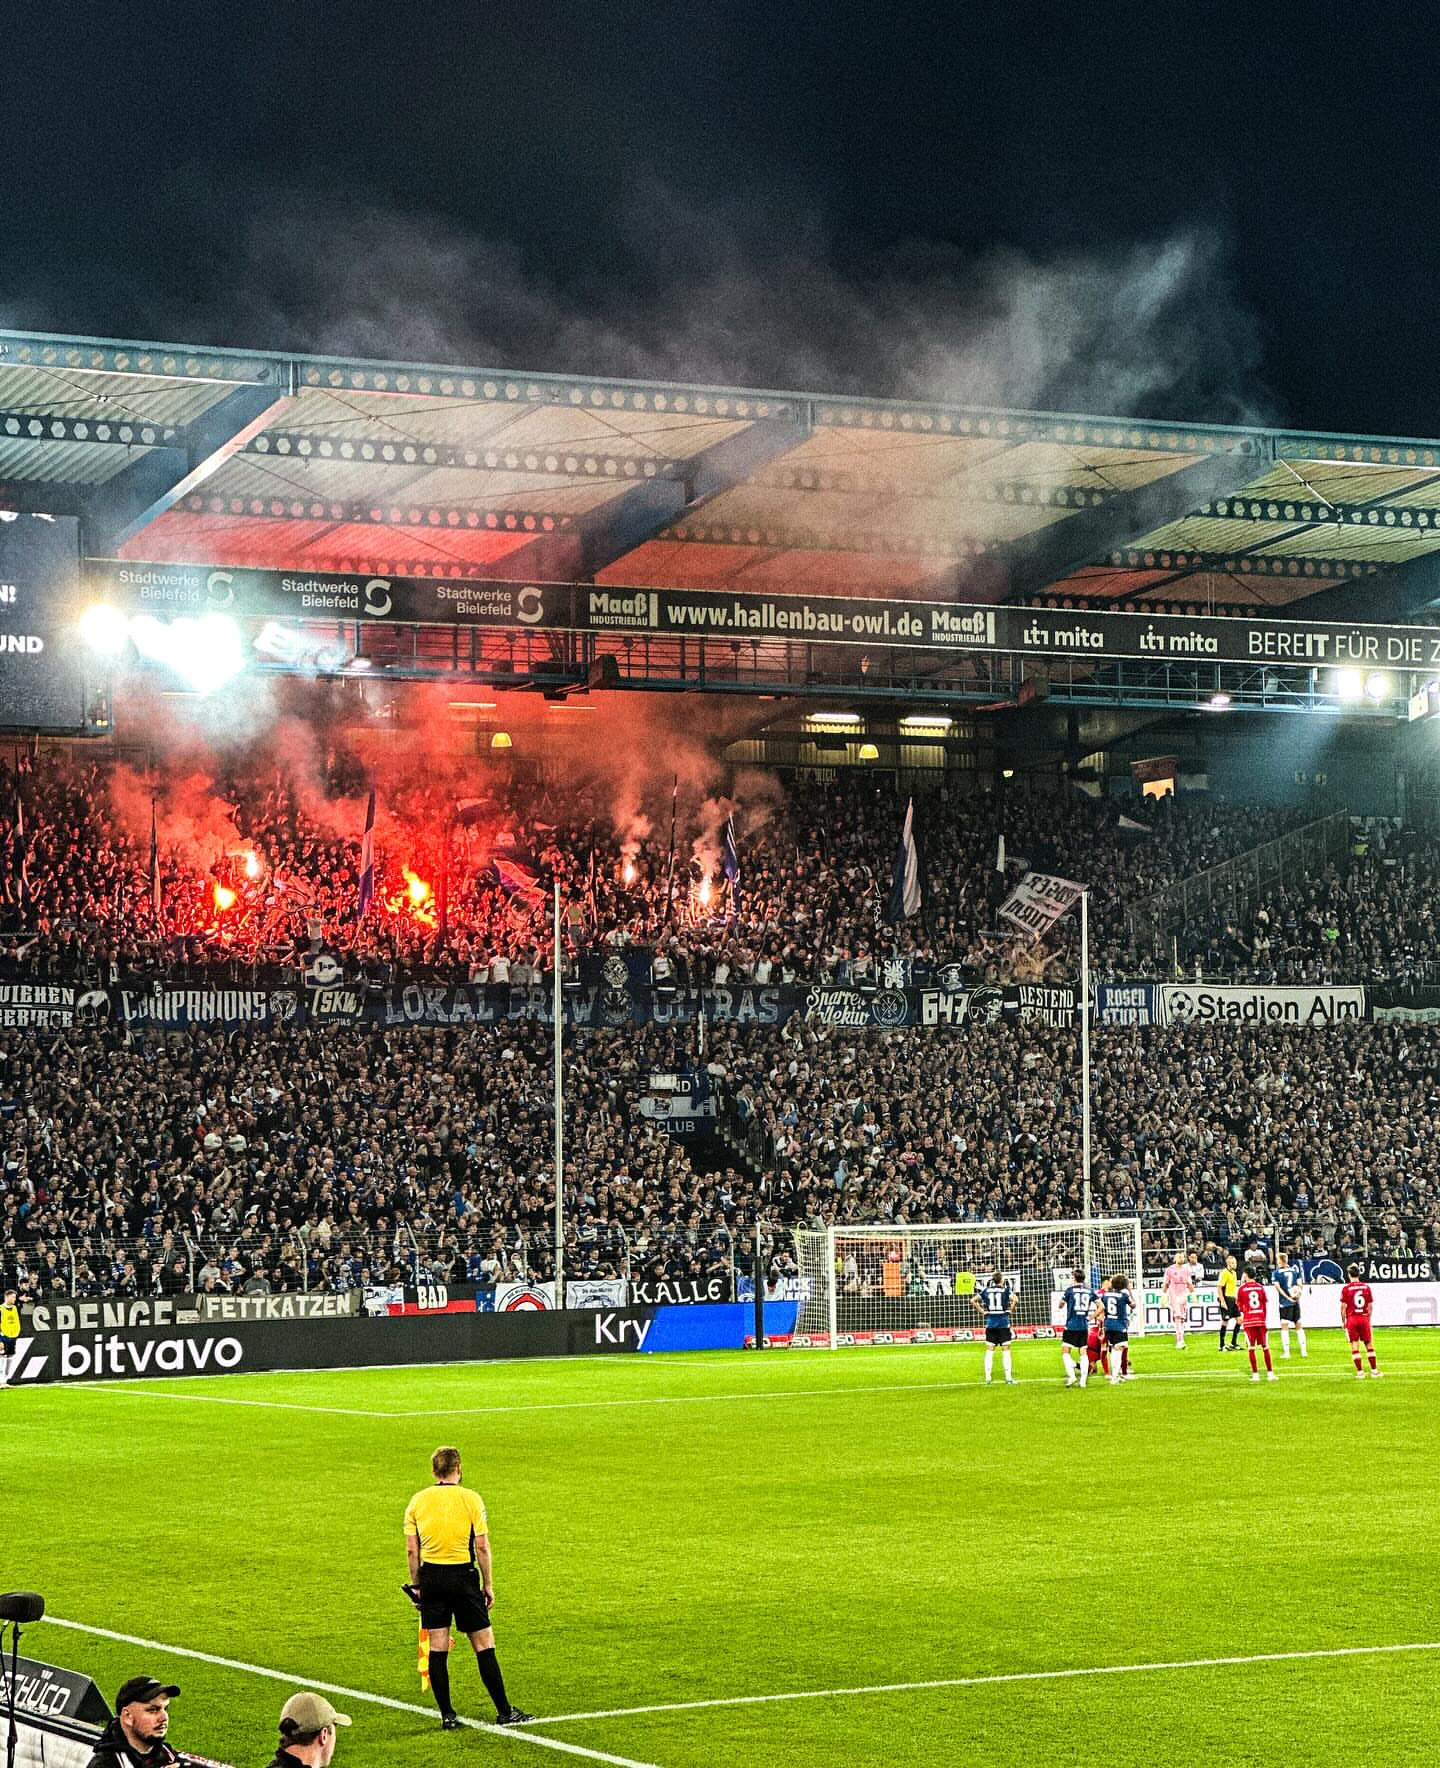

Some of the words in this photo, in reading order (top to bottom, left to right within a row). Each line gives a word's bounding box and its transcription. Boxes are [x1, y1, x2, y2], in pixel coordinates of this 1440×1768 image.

[119, 570, 200, 586] Stadtwerke
[281, 579, 359, 594] Stadtwerke
[140, 586, 200, 601] Bielefeld
[302, 594, 359, 609] Bielefeld
[436, 586, 512, 601] Stadtwerke
[456, 601, 512, 616] Bielefeld
[589, 592, 647, 617] Maaß
[589, 615, 648, 626] INDUSTRIEBAU
[667, 602, 923, 637] www.hallenbau-owl.de
[931, 610, 985, 634] Maaß
[932, 632, 986, 643] INDUSTRIEBAU
[1054, 626, 1104, 648] mita
[1170, 632, 1218, 653] mita
[1248, 631, 1330, 657] BEREIT
[1335, 630, 1379, 660] FÜR
[1387, 637, 1422, 661] DIE
[385, 985, 494, 1024] LOKAL
[923, 991, 969, 1026] 647
[1198, 994, 1299, 1021] Stadion
[1308, 994, 1359, 1021] Alm
[0, 1009, 74, 1029] EBIRGE
[805, 1004, 870, 1026] llektiv
[1369, 1261, 1431, 1279] ÁGILUS
[417, 1285, 448, 1310] BAD
[631, 1279, 723, 1304] KALLE
[1074, 1292, 1091, 1311] 19
[1248, 1291, 1260, 1309] 8
[1353, 1289, 1366, 1308] 6
[207, 1294, 351, 1319] FETTKATZEN
[988, 1293, 1003, 1311] 11
[1107, 1297, 1118, 1315] 6
[595, 1313, 652, 1350] Kry
[61, 1334, 243, 1377] bitvavo
